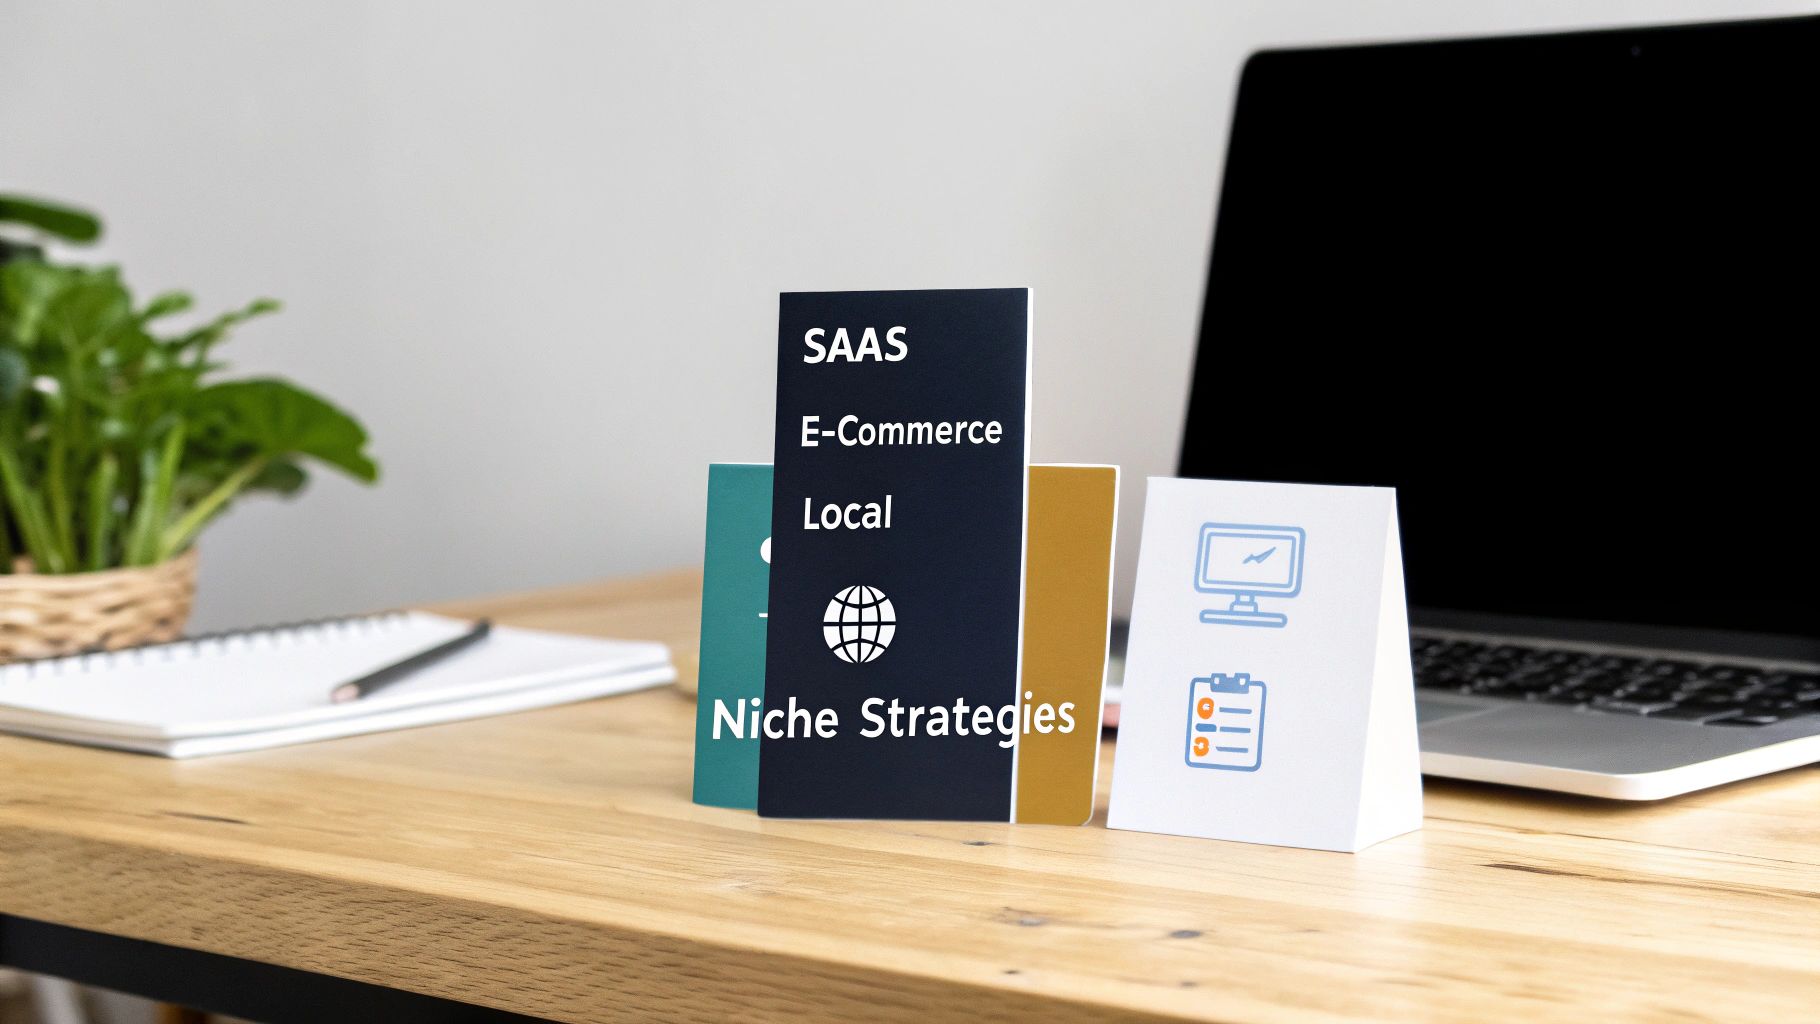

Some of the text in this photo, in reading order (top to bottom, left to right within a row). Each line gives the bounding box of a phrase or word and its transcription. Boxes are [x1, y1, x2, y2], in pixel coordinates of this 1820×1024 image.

[803, 325, 908, 364] SAAS
[801, 414, 1002, 447] E-Commerce
[804, 494, 892, 530] Local
[712, 691, 1076, 749] Niche Strategies
